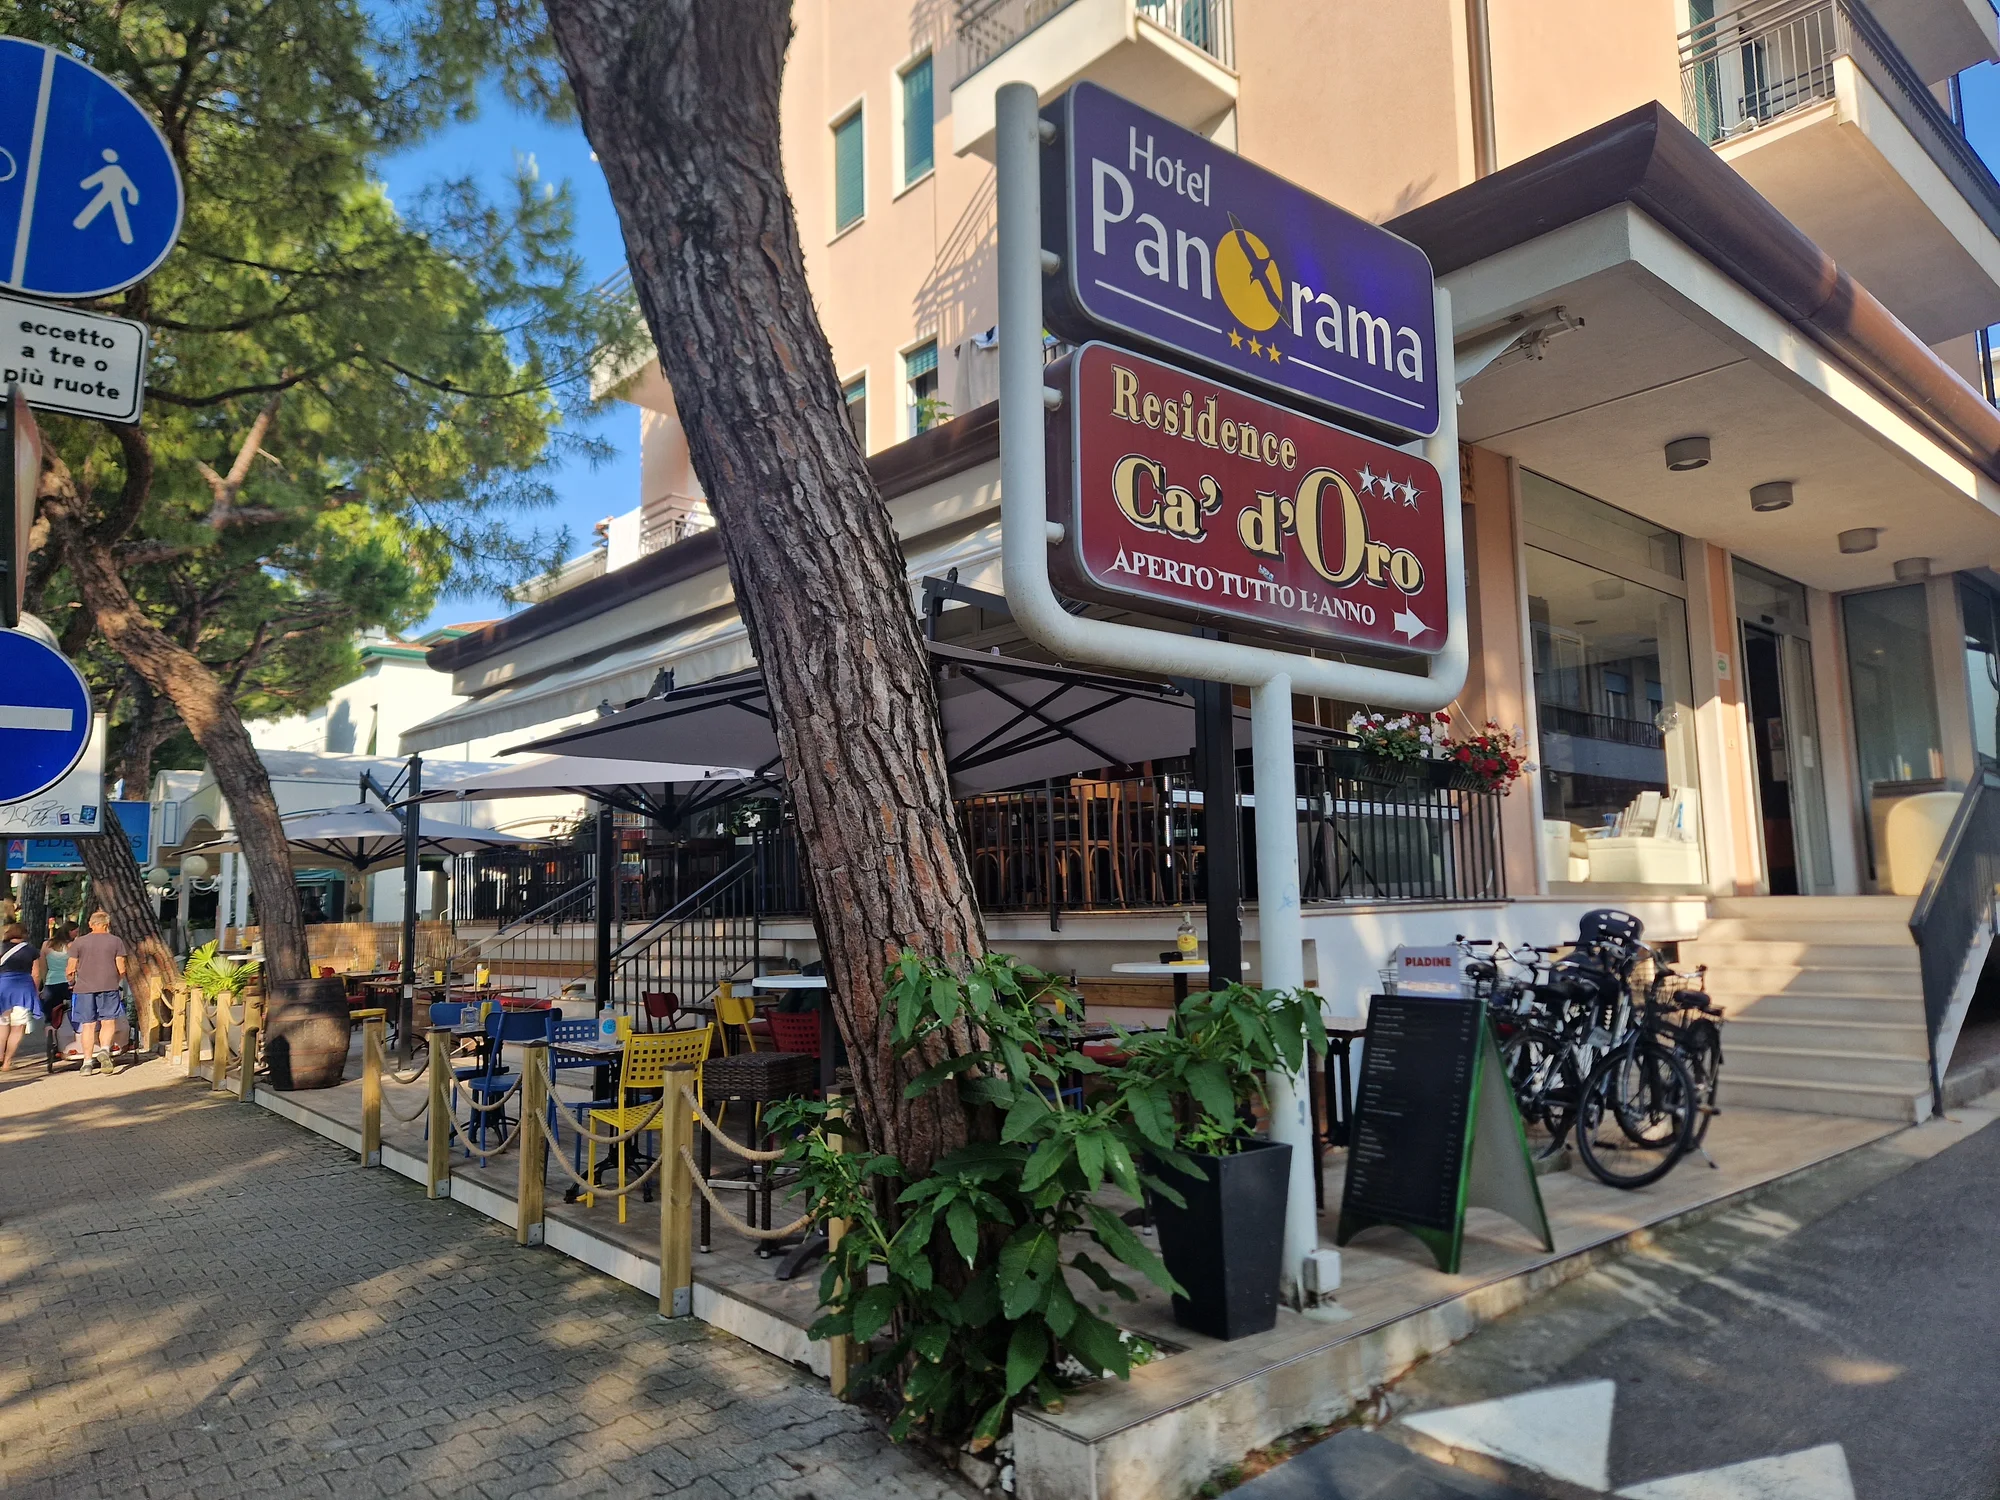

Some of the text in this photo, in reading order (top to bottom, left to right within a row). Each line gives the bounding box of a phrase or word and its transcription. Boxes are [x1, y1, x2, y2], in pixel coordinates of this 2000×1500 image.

[1129, 126, 1211, 207] Hotel
[20, 320, 115, 349] eccetto
[21, 345, 108, 372] a tre o
[4, 367, 120, 400] più ruote
[1111, 364, 1298, 470] Residence
[1113, 454, 1425, 596] Ca' d'Oro
[1102, 542, 1213, 591] APERTO
[1213, 568, 1295, 609] TUTTO
[1299, 588, 1376, 626] L'ANNO
[1404, 956, 1452, 967] PIADINE
